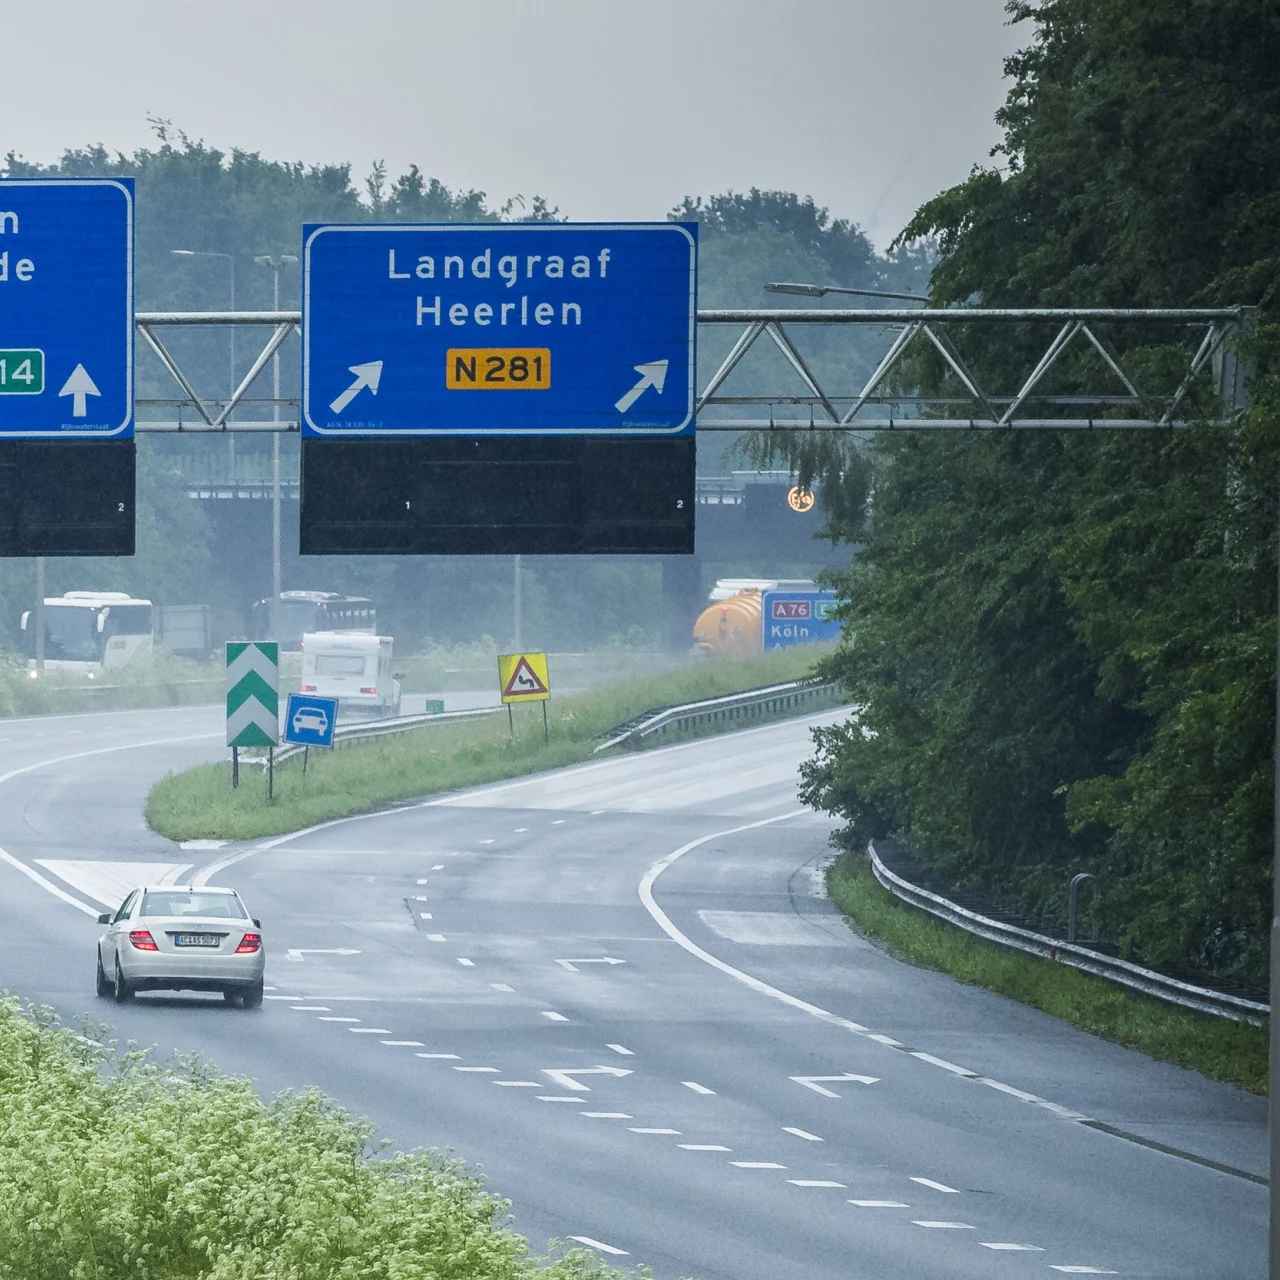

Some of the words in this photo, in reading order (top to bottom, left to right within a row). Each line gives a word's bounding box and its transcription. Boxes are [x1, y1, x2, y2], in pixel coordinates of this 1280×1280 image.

[388, 247, 612, 289] Landgraaf
[416, 295, 583, 327] Heerlen
[117, 502, 125, 512] 2
[405, 500, 411, 510] 1
[676, 499, 684, 509] 2
[771, 624, 809, 637] Köln
